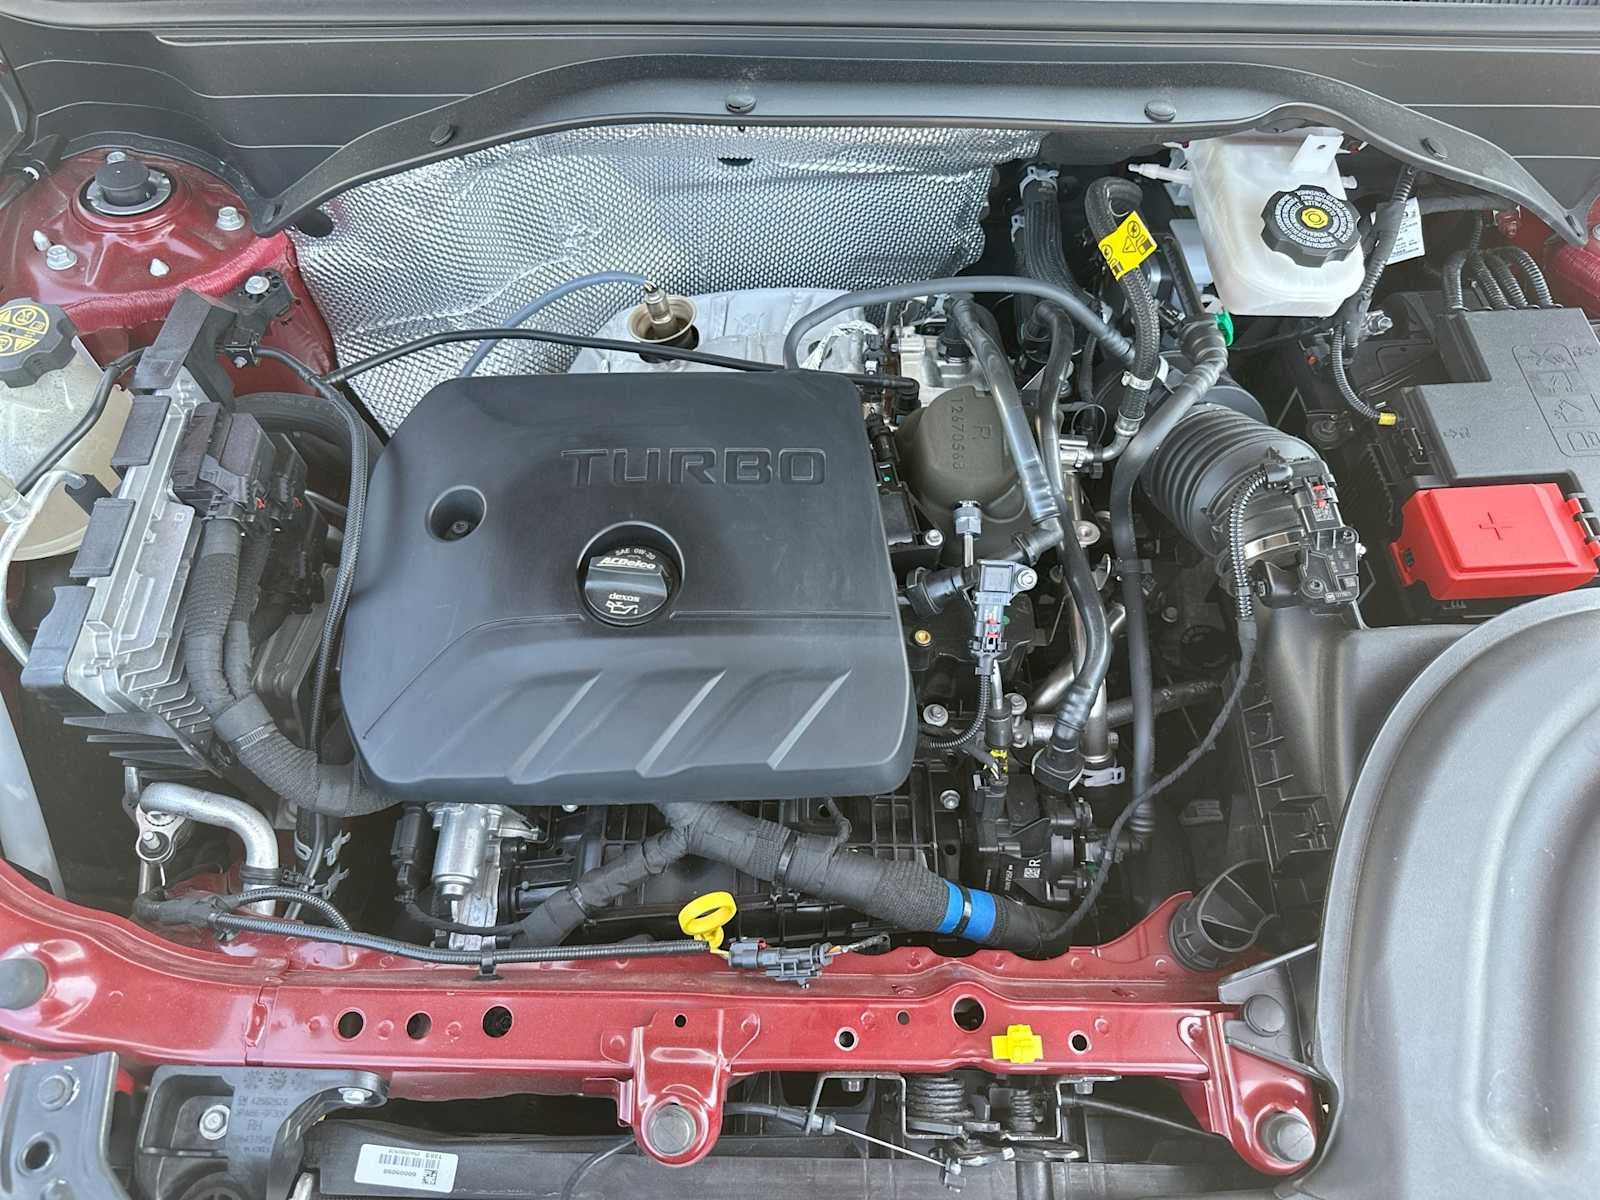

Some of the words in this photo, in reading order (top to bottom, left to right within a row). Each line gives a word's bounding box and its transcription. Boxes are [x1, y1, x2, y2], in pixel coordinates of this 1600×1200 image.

[973, 424, 991, 441] R
[560, 447, 827, 488] TURBO
[615, 548, 631, 556] SAE
[597, 556, 656, 570] ACDelco
[608, 592, 640, 603] dexos
[1028, 859, 1041, 867] R
